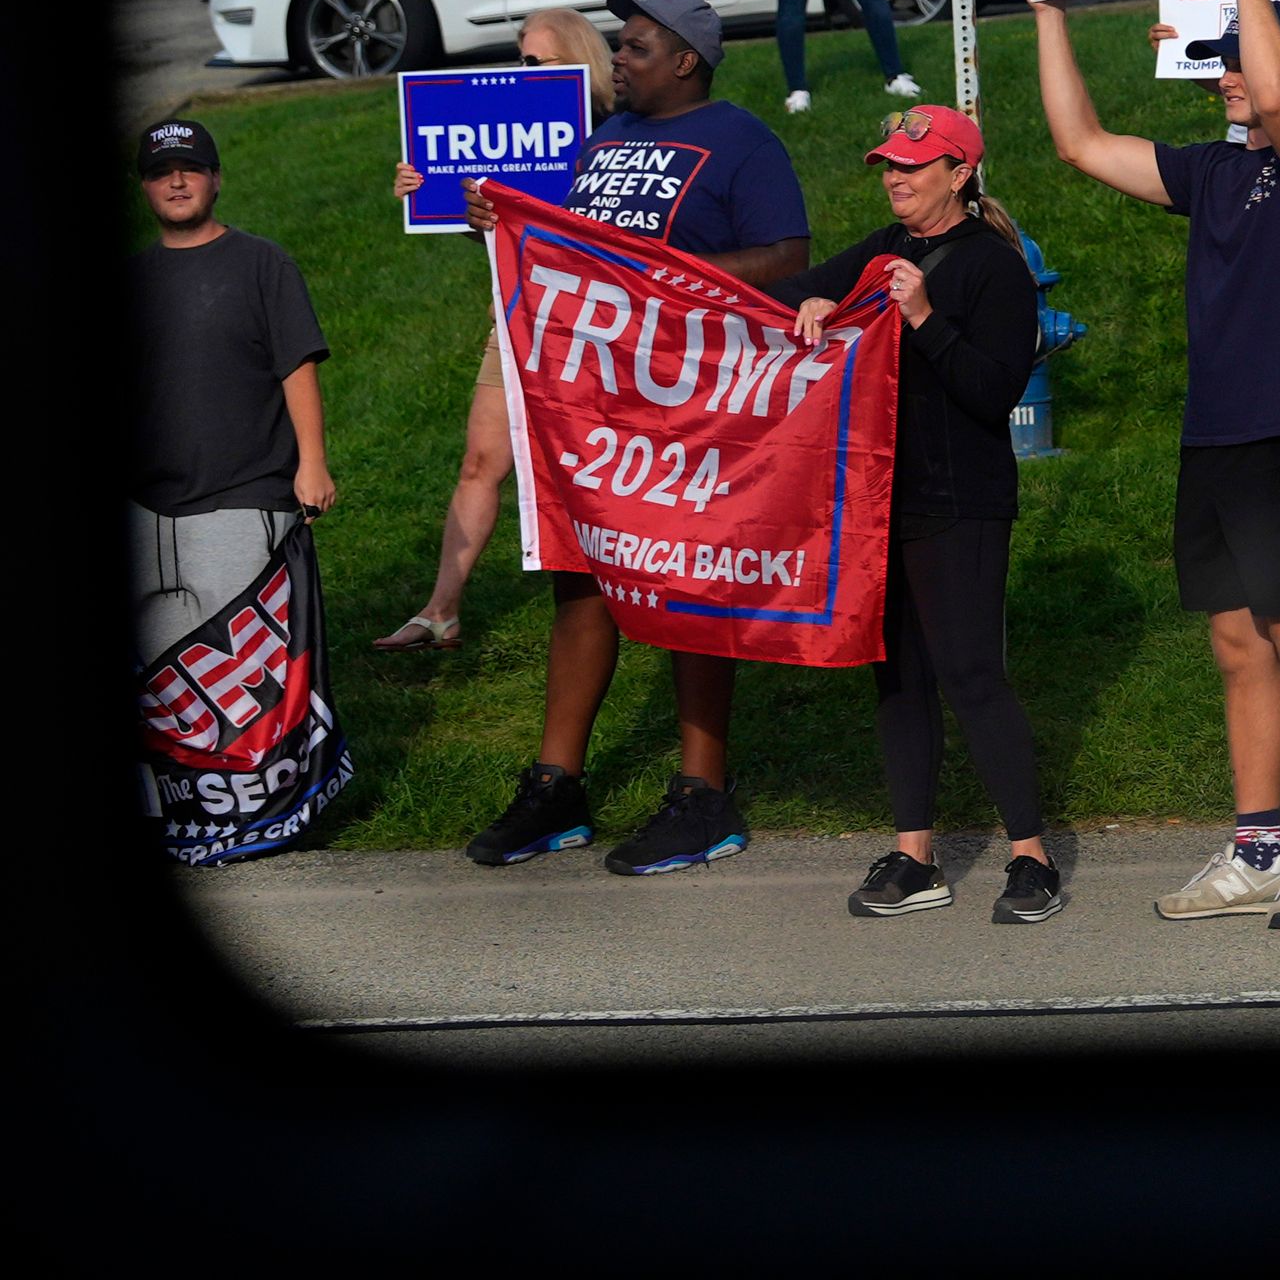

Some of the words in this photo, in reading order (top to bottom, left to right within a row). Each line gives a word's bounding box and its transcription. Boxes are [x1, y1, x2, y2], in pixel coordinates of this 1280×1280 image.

[150, 126, 194, 142] TRUMP
[418, 121, 575, 161] TRUMP
[428, 165, 455, 175] MAKE
[457, 164, 500, 174] AMERICA
[502, 163, 533, 173] GREAT
[535, 162, 568, 172] AGAIN!
[588, 149, 676, 172] MEAN
[589, 196, 621, 208] AND
[615, 210, 661, 230] GAS
[692, 544, 806, 587] BACK!
[158, 774, 194, 806] The
[264, 803, 312, 839] CRY
